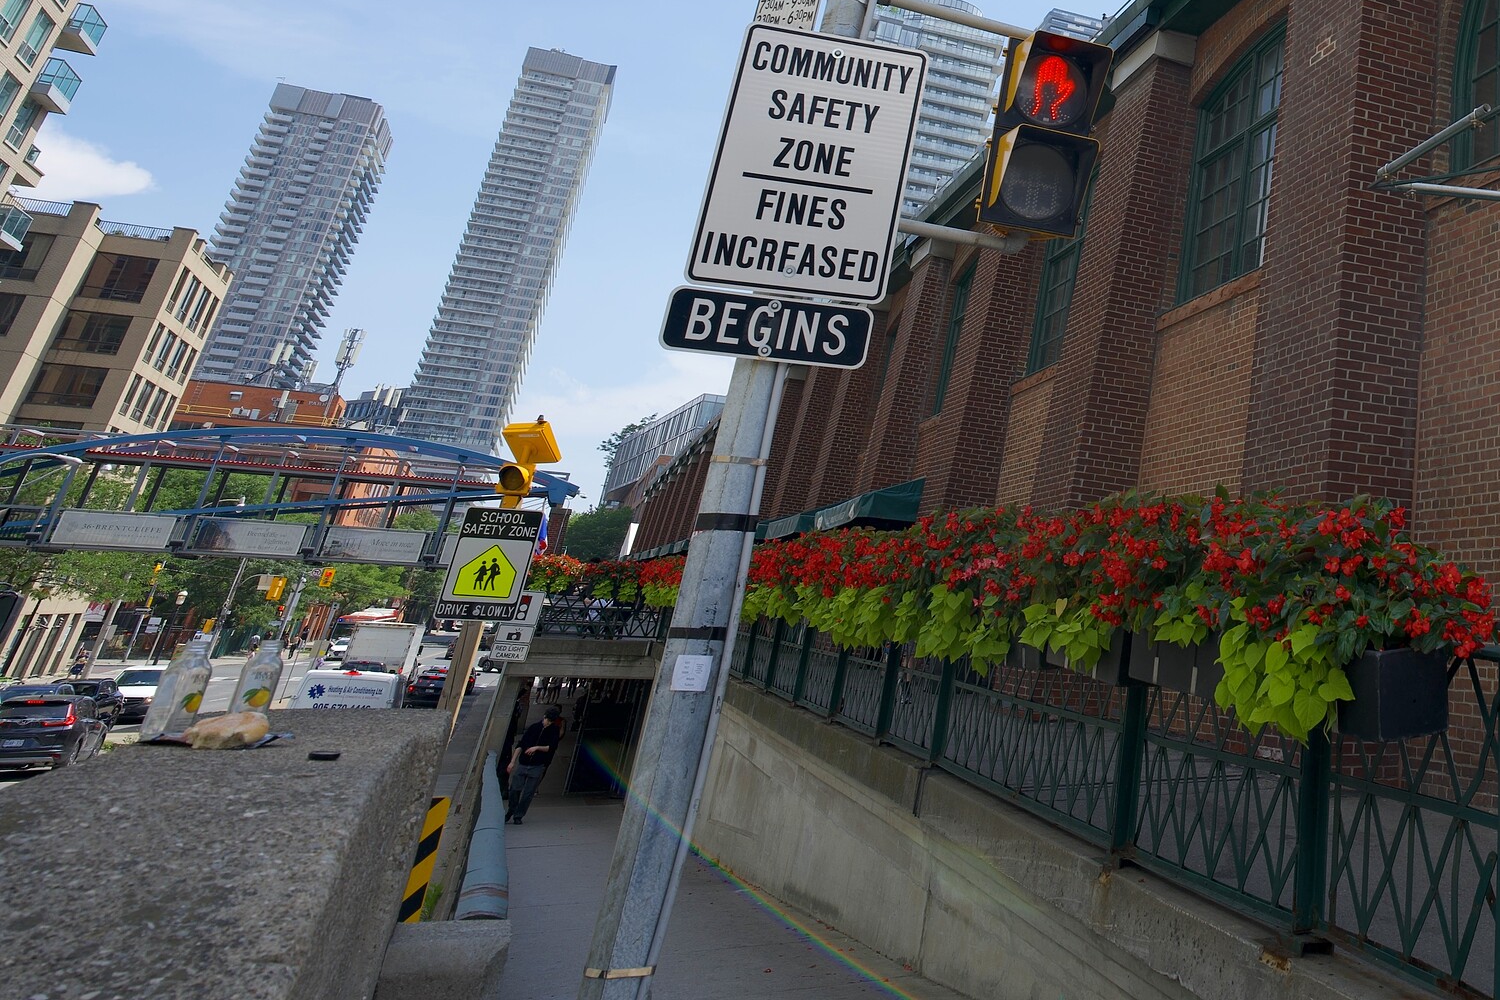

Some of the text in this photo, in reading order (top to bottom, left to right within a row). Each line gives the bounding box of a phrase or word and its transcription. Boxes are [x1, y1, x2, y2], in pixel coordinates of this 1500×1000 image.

[752, 41, 914, 95] COMMUNITY
[769, 89, 880, 134] SAFETY
[773, 137, 855, 178] ZONE
[755, 188, 847, 231] FINES
[701, 231, 879, 283] INCREASED
[684, 298, 849, 357] BEGINS
[463, 523, 538, 538] SAFETY ZONE
[480, 511, 526, 525] SCHOOL
[436, 603, 515, 618] DRIVE SLOWLY
[495, 652, 520, 660] CAMERA
[508, 645, 525, 653] LIGHT
